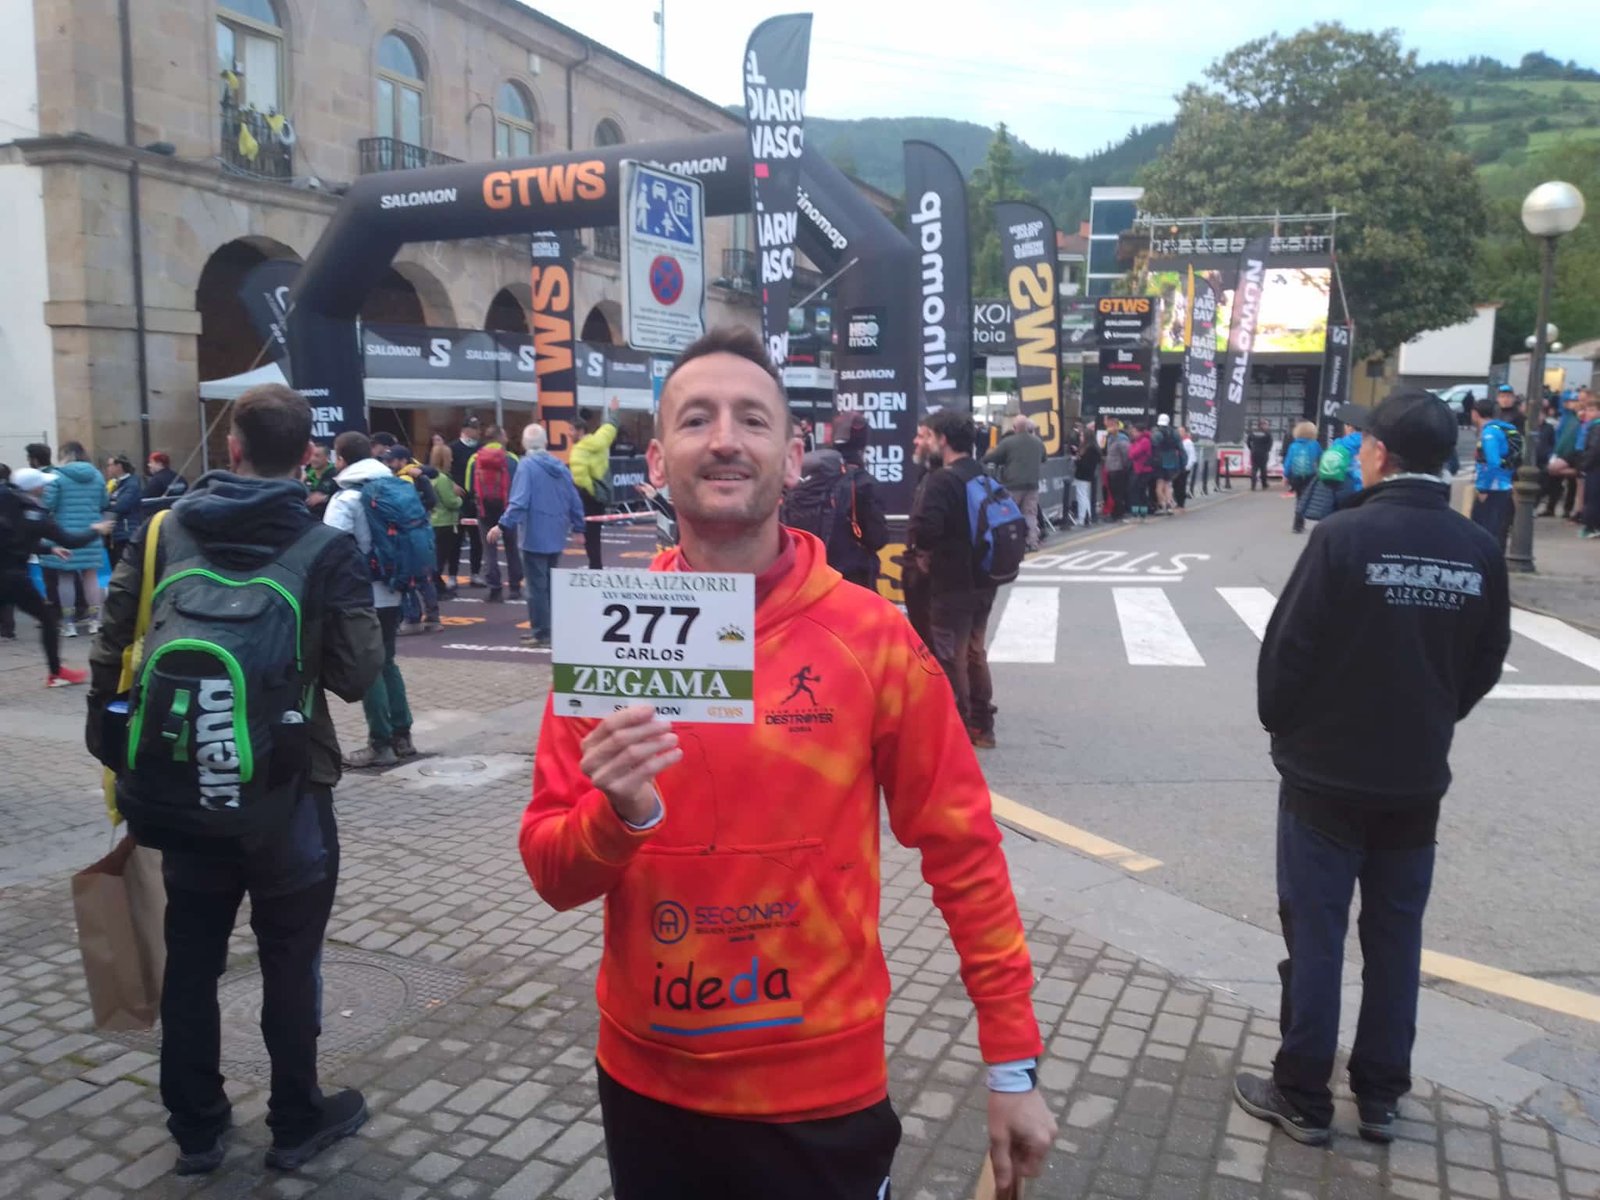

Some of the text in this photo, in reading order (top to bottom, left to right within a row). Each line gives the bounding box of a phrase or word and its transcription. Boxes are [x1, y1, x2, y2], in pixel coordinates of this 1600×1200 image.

[747, 87, 806, 121] DIARI
[483, 160, 606, 209] GTWS
[381, 188, 457, 209] SALOMON
[911, 191, 957, 391] kinomap
[1099, 298, 1150, 313] GTWS
[849, 322, 879, 337] HBO
[849, 336, 878, 347] max
[1228, 258, 1263, 405] SALOMON
[366, 344, 421, 357] SALOMON
[429, 339, 452, 367] S
[465, 349, 512, 362] SALOMON
[531, 265, 574, 464] GTWS
[841, 369, 895, 380] SALOMON
[1098, 406, 1145, 415] SALOMON
[863, 445, 904, 464] RLD
[1018, 549, 1211, 574] STOP
[568, 573, 738, 593] ZEGAMA-AIZKORRI
[1384, 587, 1466, 605] AIZKORRI
[602, 604, 700, 645] 277
[615, 647, 684, 661] CARLOS
[573, 666, 731, 698] ZEGAMA
[707, 706, 743, 718] GTWS
[196, 679, 241, 811] arena
[694, 901, 800, 926] SECONAY
[653, 955, 792, 1011] ideda
